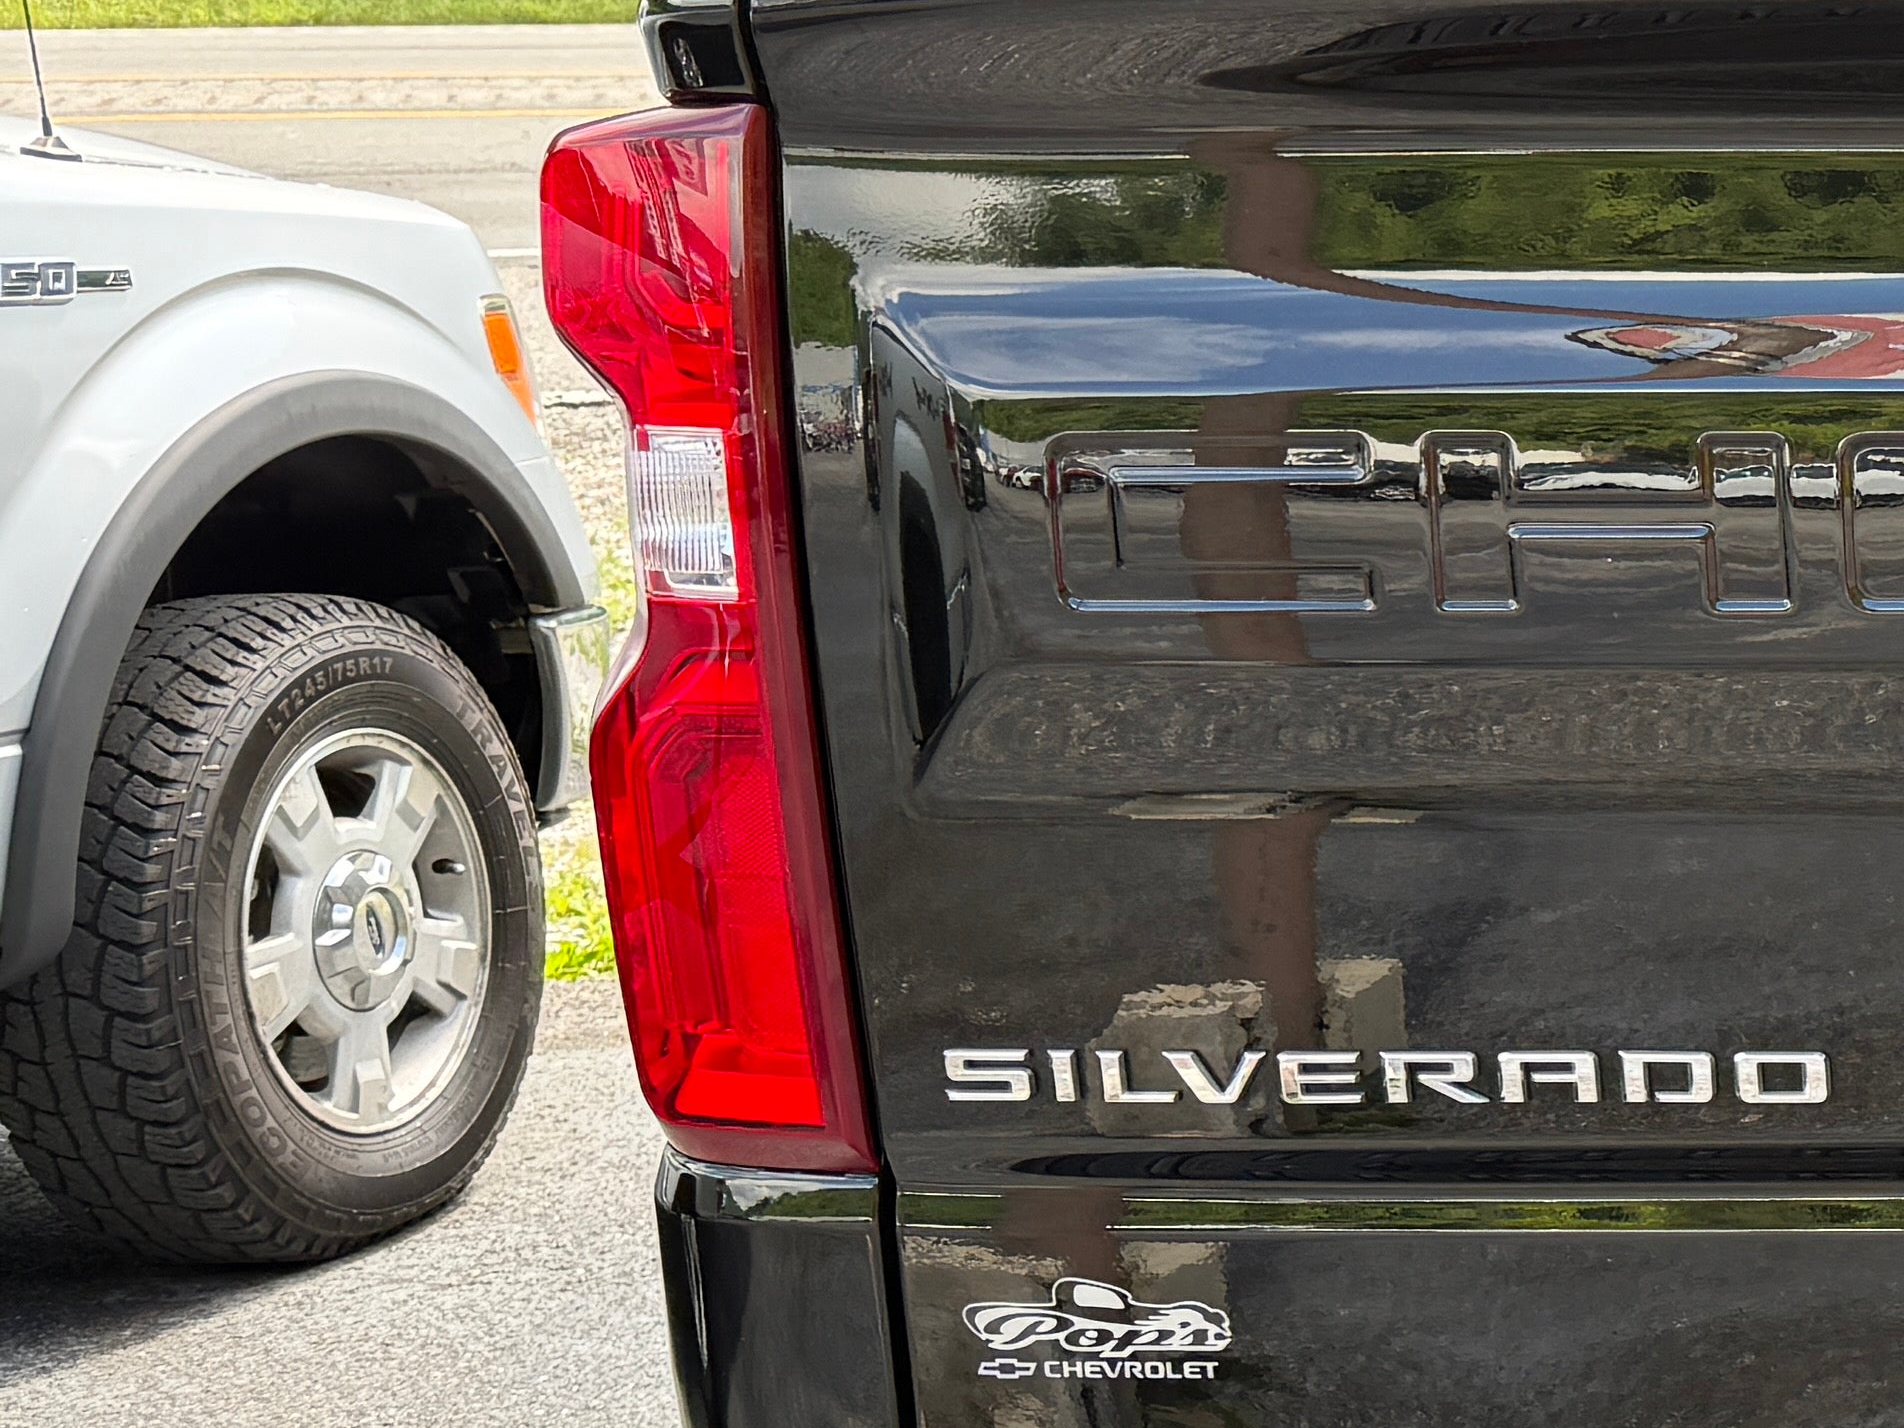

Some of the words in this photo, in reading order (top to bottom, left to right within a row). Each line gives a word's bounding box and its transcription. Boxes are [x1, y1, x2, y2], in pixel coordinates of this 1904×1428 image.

[265, 656, 394, 735] LT245/75R17
[942, 1047, 1832, 1106] SILVERADO
[1043, 1360, 1220, 1380] CHEVROLET
